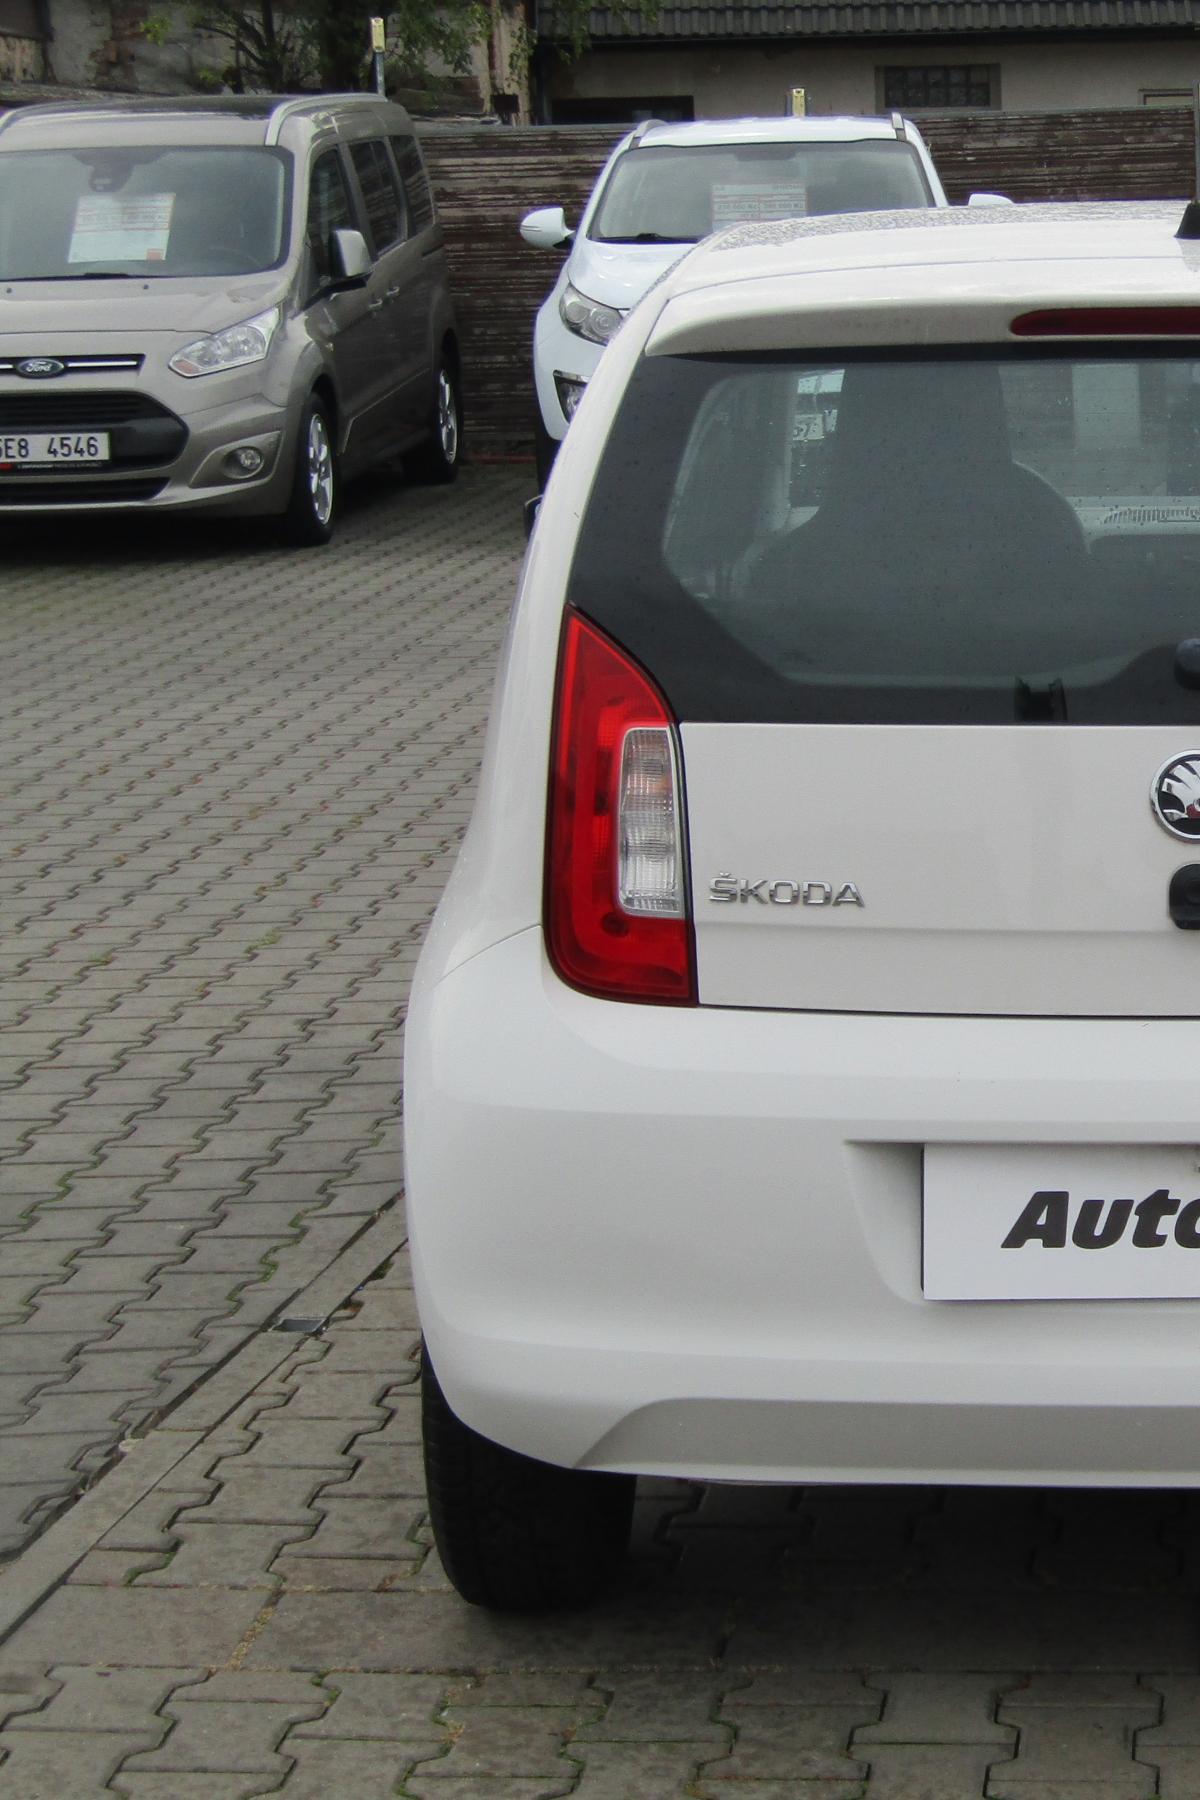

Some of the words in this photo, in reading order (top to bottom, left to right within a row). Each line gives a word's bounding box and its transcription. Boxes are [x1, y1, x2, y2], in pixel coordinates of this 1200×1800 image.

[26, 361, 52, 372] Ford
[47, 436, 99, 458] 4546
[709, 872, 865, 908] ŠKODA
